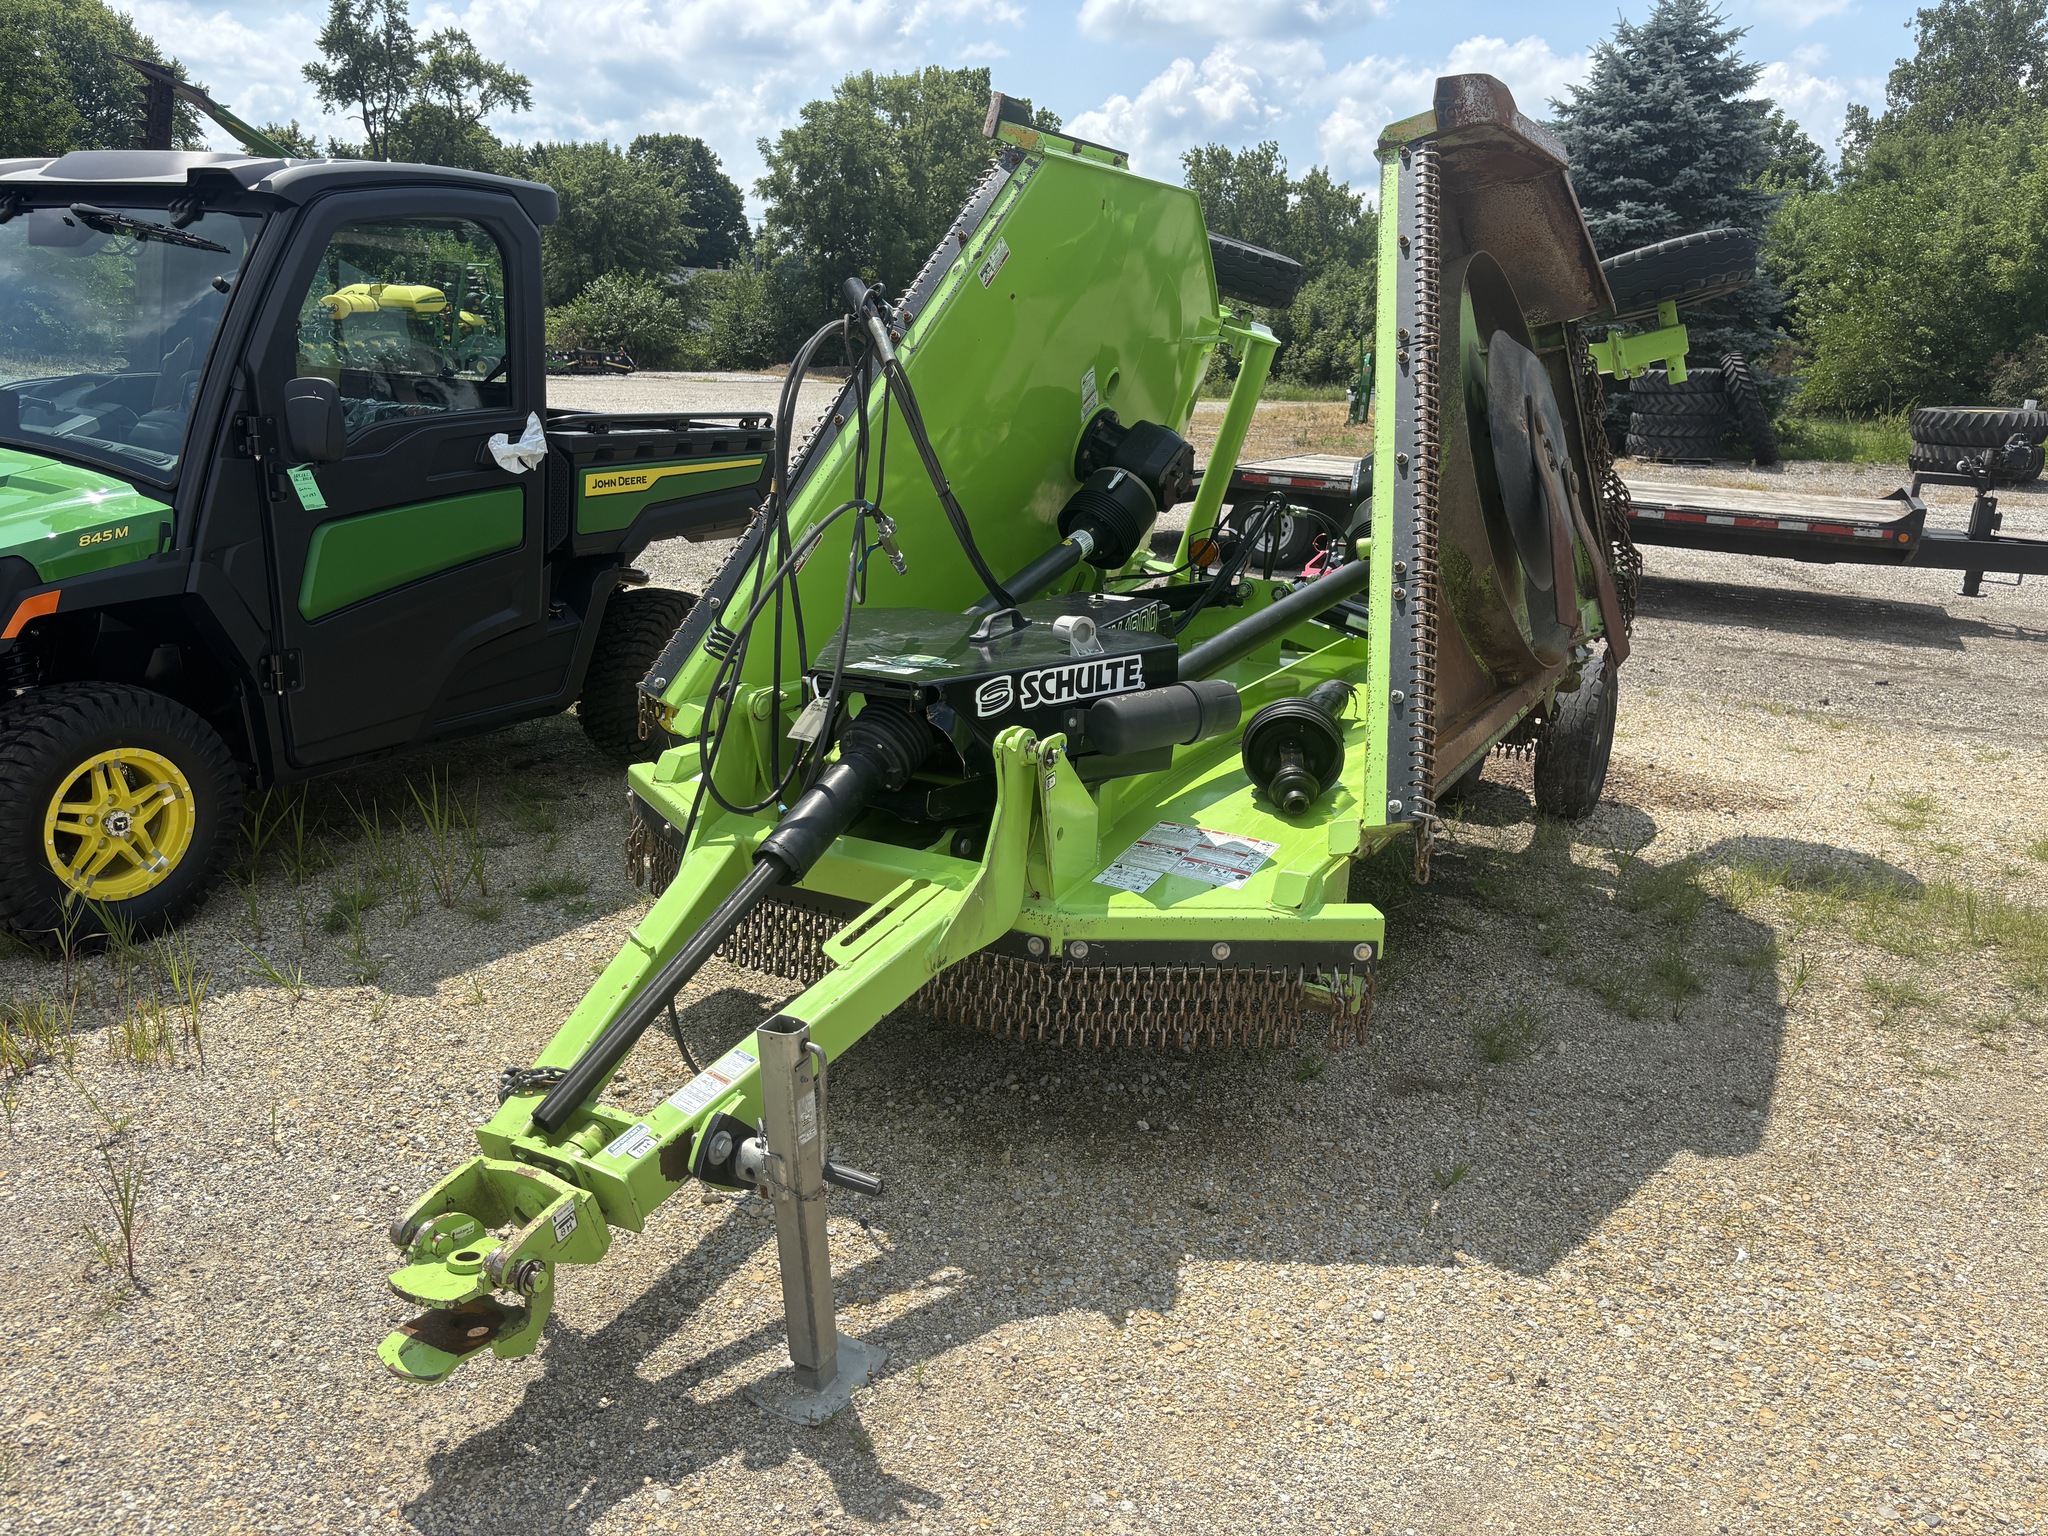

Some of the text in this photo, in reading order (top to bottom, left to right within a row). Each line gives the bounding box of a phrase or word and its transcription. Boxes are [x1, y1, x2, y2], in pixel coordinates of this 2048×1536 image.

[592, 475, 648, 489] JOHN DEERE
[1020, 654, 1143, 709] SCHULTE
